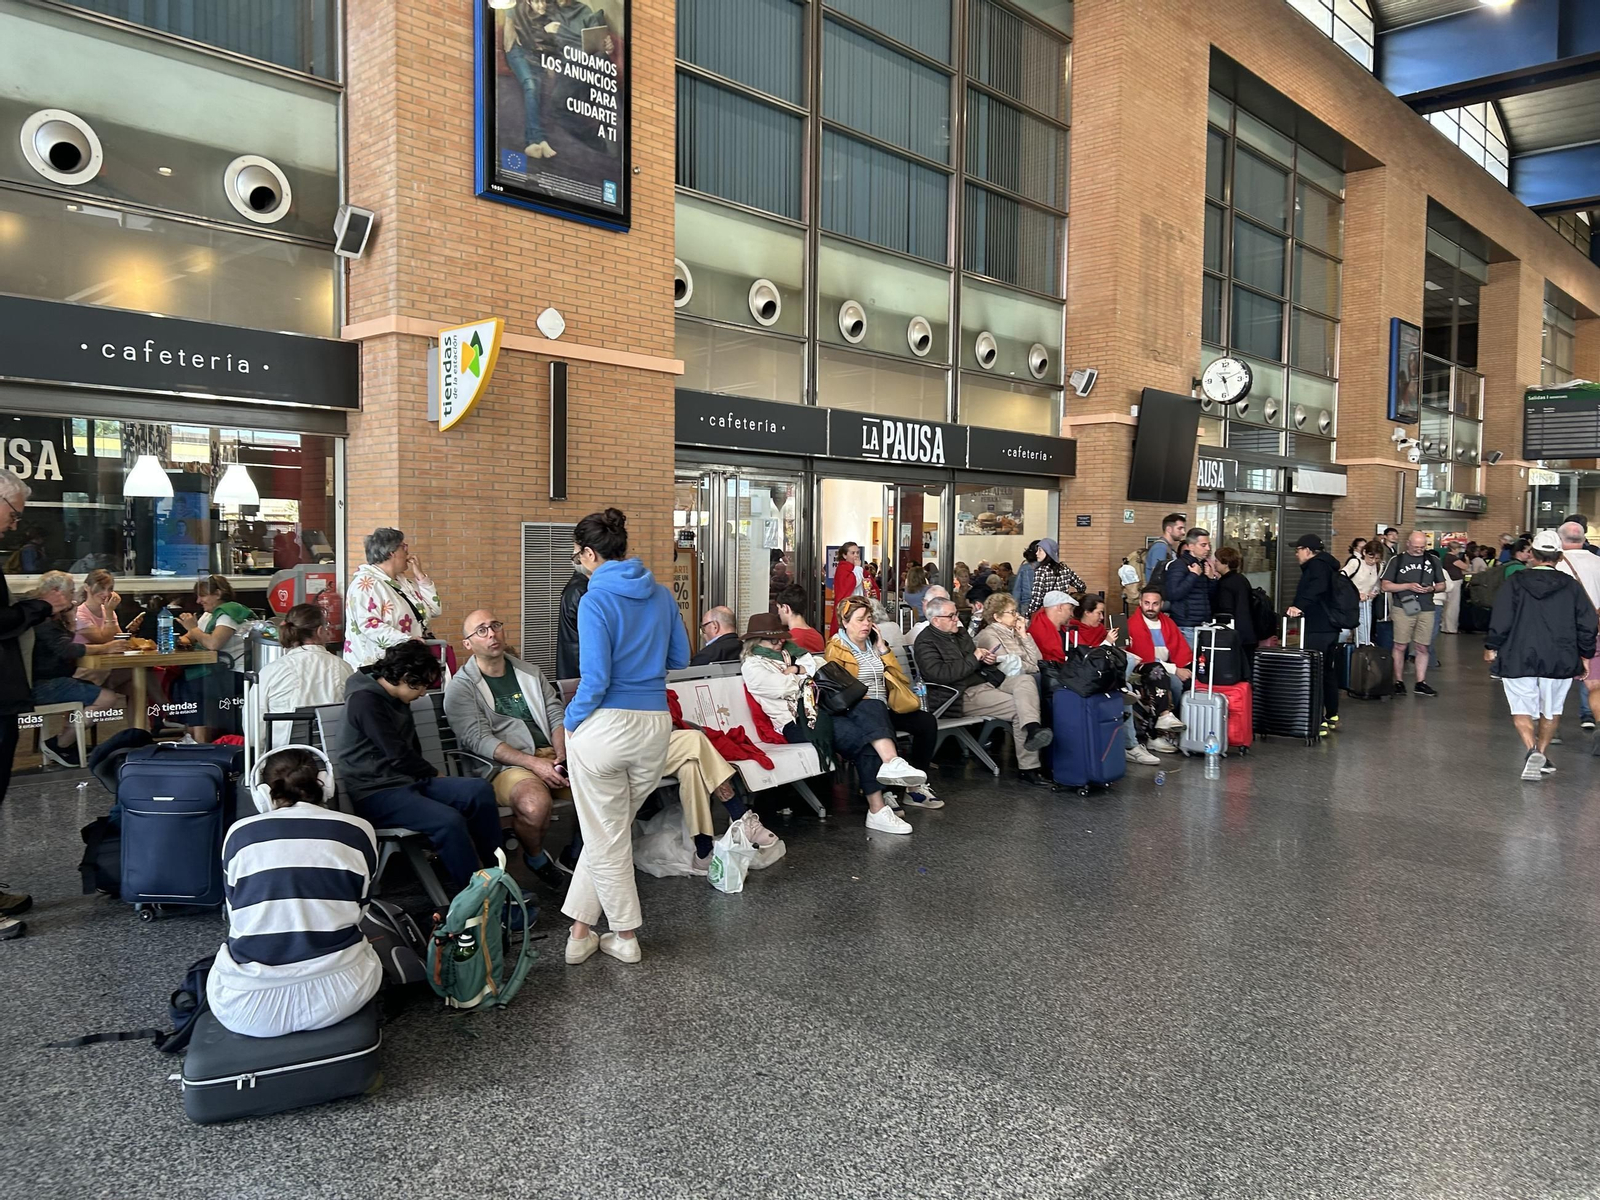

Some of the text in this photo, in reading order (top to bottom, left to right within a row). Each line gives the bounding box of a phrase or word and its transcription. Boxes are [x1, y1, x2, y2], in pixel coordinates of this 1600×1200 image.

[541, 53, 617, 93] LOS ANUNCIOS
[563, 45, 617, 77] CUIDAMOS
[566, 97, 617, 126] CUIDARTE
[590, 88, 617, 110] PARA
[597, 124, 617, 142] A TI
[101, 339, 250, 374] cafetería
[443, 336, 453, 418] tiendas
[709, 412, 777, 433] cafetería
[862, 420, 946, 464] LA PAUSA
[1197, 459, 1225, 489] AUSA
[18, 714, 43, 724] ndas
[85, 707, 124, 718] tiendas
[161, 701, 198, 712] tiendas
